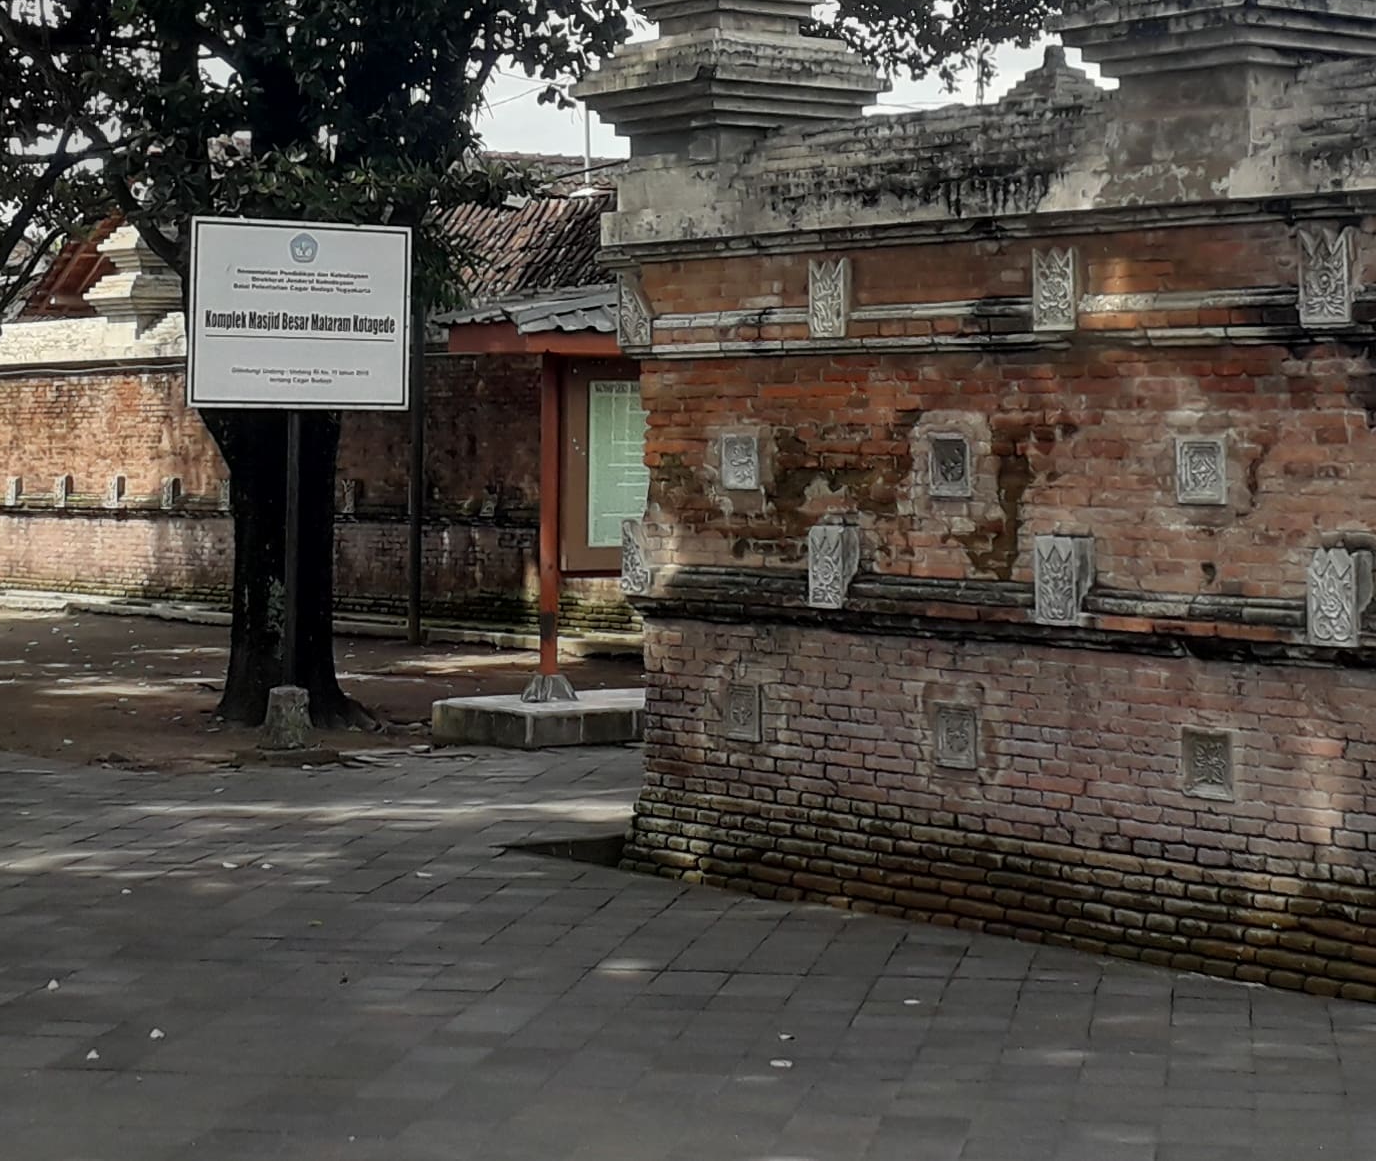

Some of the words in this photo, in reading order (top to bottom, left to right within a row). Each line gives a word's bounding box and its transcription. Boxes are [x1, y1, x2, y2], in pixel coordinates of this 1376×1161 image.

[205, 309, 247, 330] Komplek
[248, 311, 281, 331] Masjid
[282, 312, 309, 330] Besar
[311, 313, 352, 332] Mataram
[353, 314, 395, 335] Kotagede
